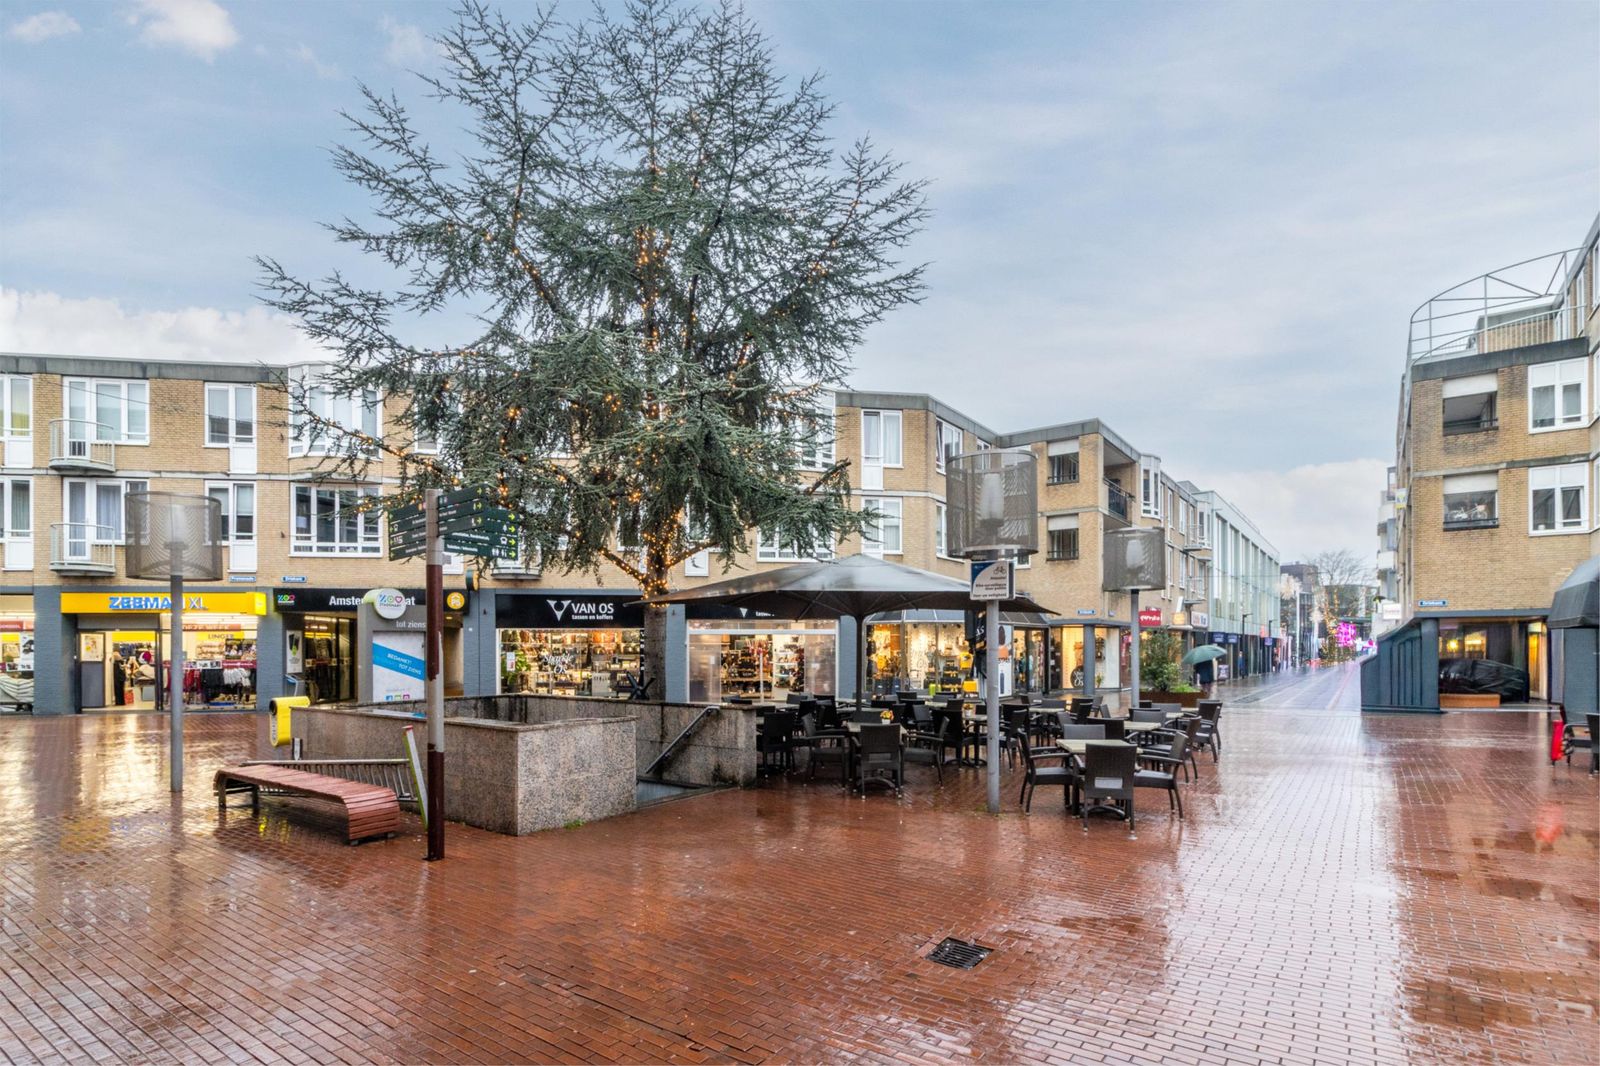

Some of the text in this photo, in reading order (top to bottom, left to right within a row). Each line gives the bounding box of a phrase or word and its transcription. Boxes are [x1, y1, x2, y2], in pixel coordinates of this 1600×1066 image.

[109, 597, 205, 608] ZEEMA XL
[571, 603, 614, 614] VAN OS
